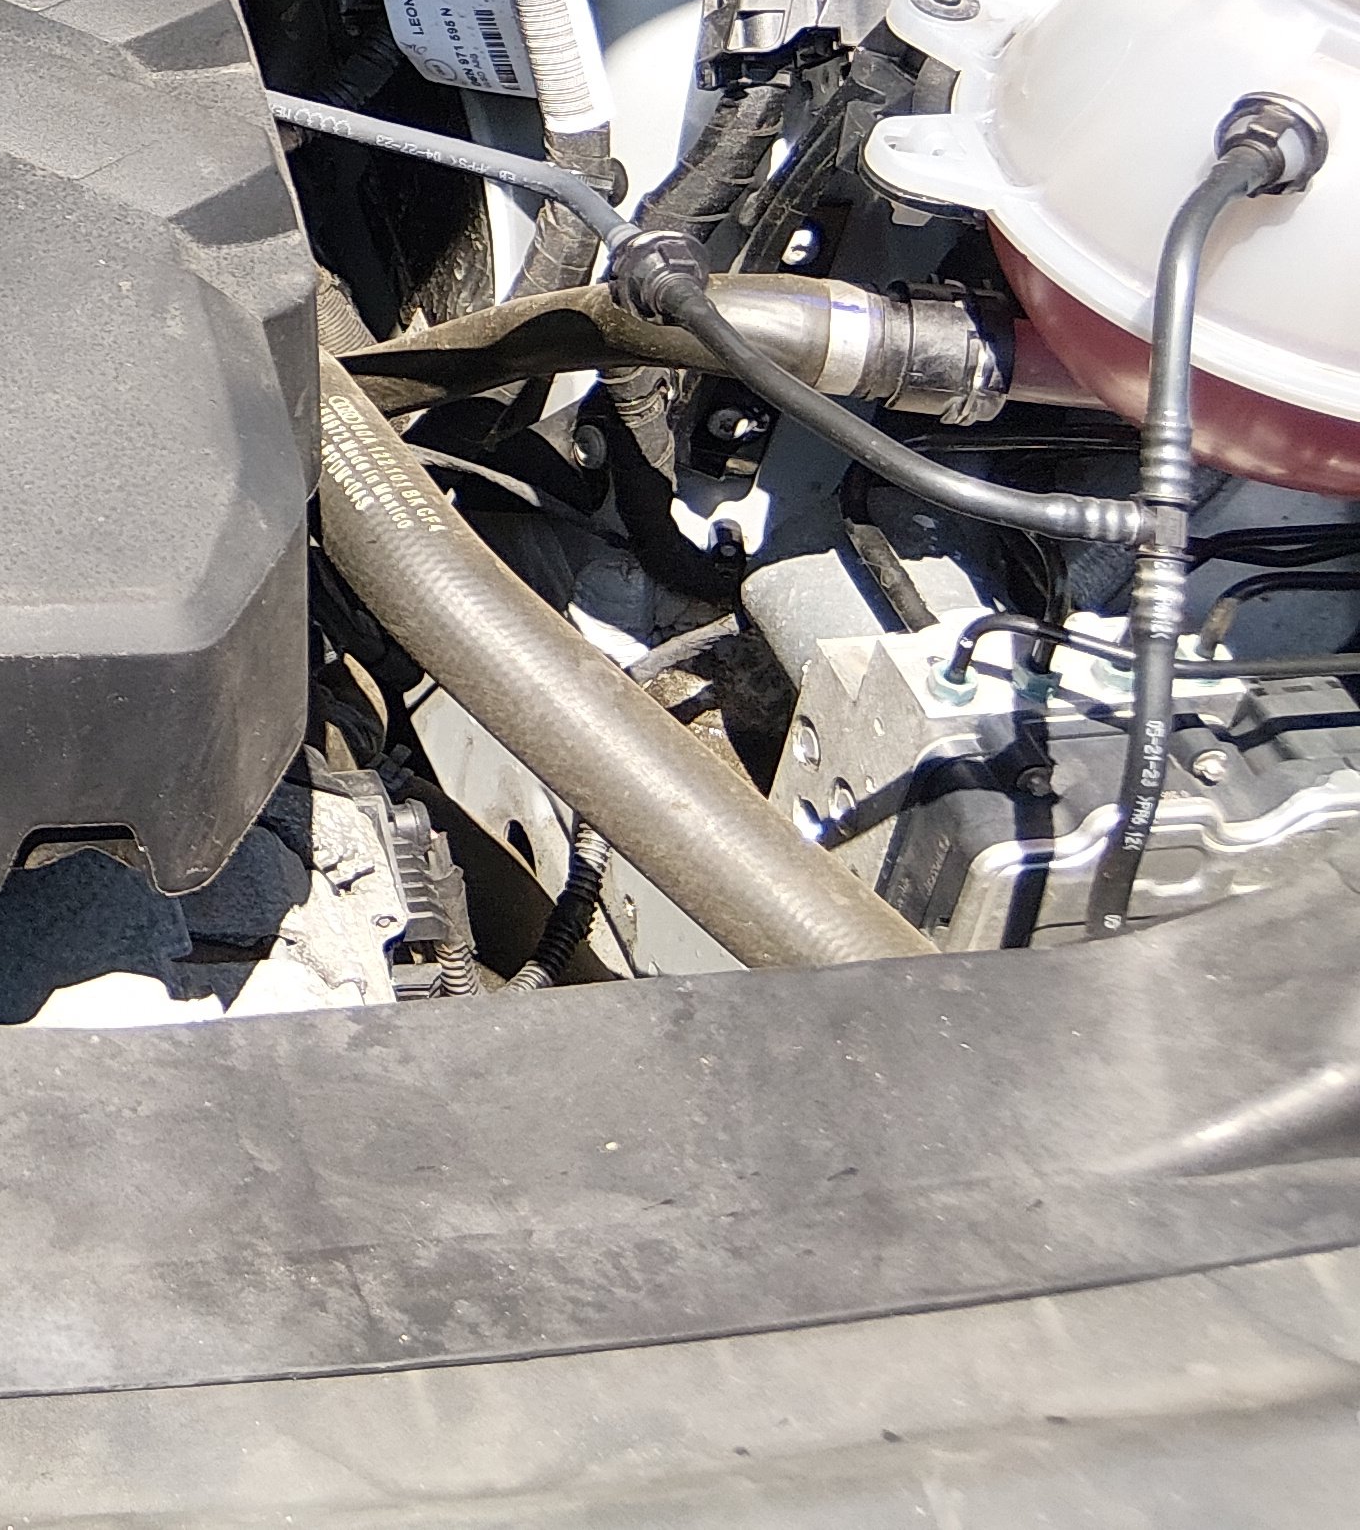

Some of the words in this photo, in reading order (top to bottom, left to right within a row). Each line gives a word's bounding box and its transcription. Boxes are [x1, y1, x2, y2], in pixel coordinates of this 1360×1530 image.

[440, 7, 454, 17] N
[453, 45, 470, 66] 971
[338, 439, 370, 471] Made
[361, 469, 380, 484] in
[371, 482, 414, 529] Mexico
